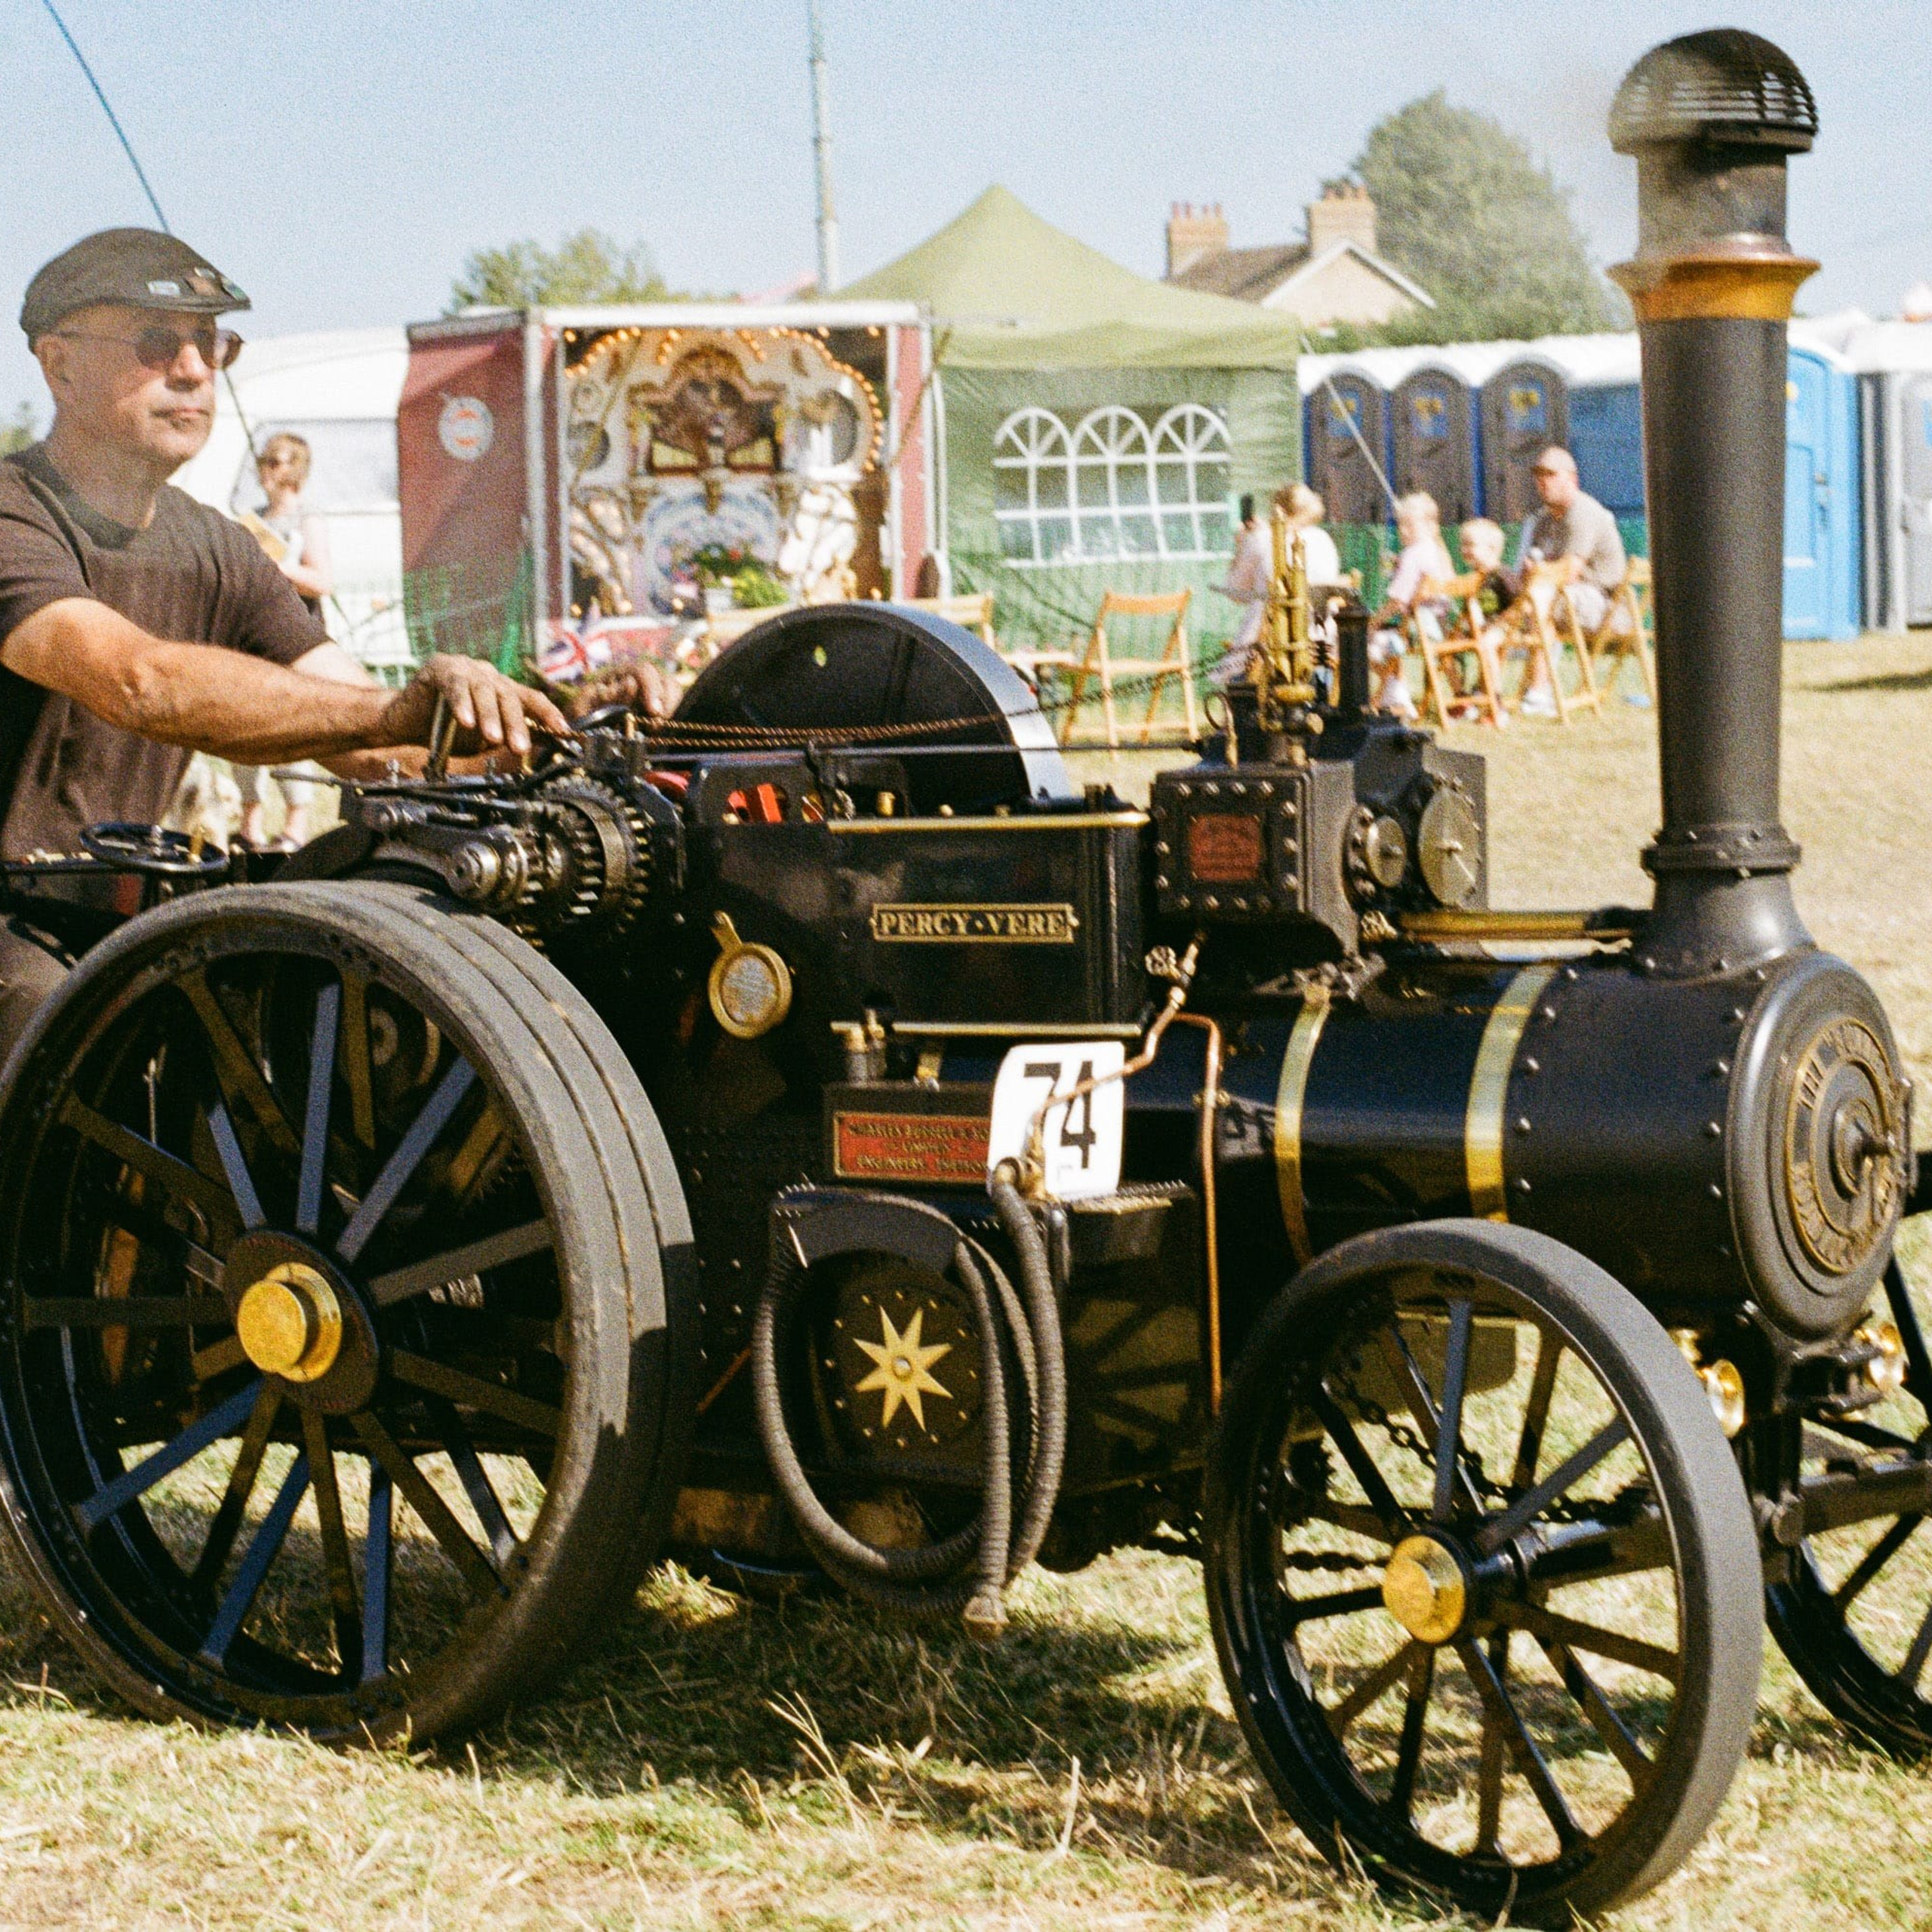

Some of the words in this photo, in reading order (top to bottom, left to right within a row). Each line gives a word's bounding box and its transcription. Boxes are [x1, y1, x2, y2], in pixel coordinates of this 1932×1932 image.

[878, 912, 971, 934] PERCY
[985, 912, 1066, 936] VERE
[1024, 1060, 1096, 1169] 74
